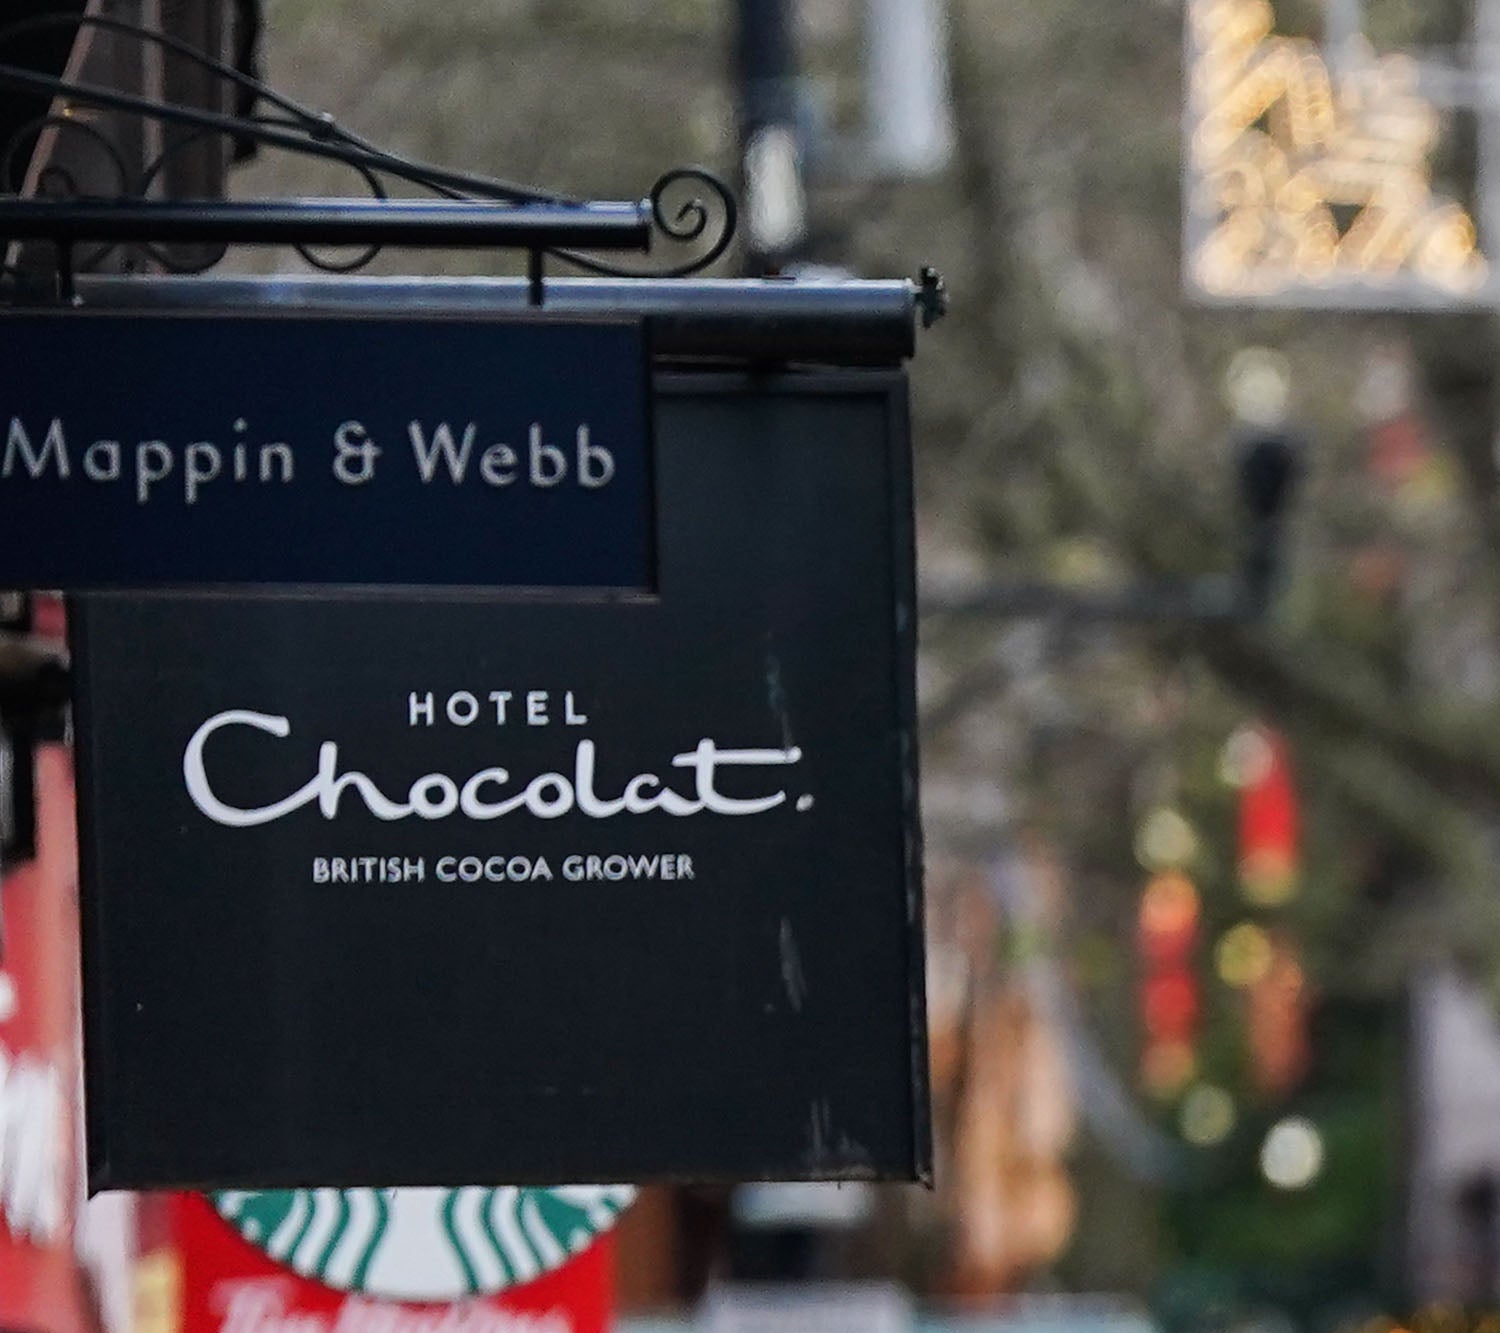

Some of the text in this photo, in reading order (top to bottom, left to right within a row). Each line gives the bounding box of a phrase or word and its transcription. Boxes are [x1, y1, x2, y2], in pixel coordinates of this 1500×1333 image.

[2, 416, 616, 503] Mappin & Webb
[408, 690, 588, 726] HOTEL
[312, 854, 695, 883] BRITISH COCOA GROWER
